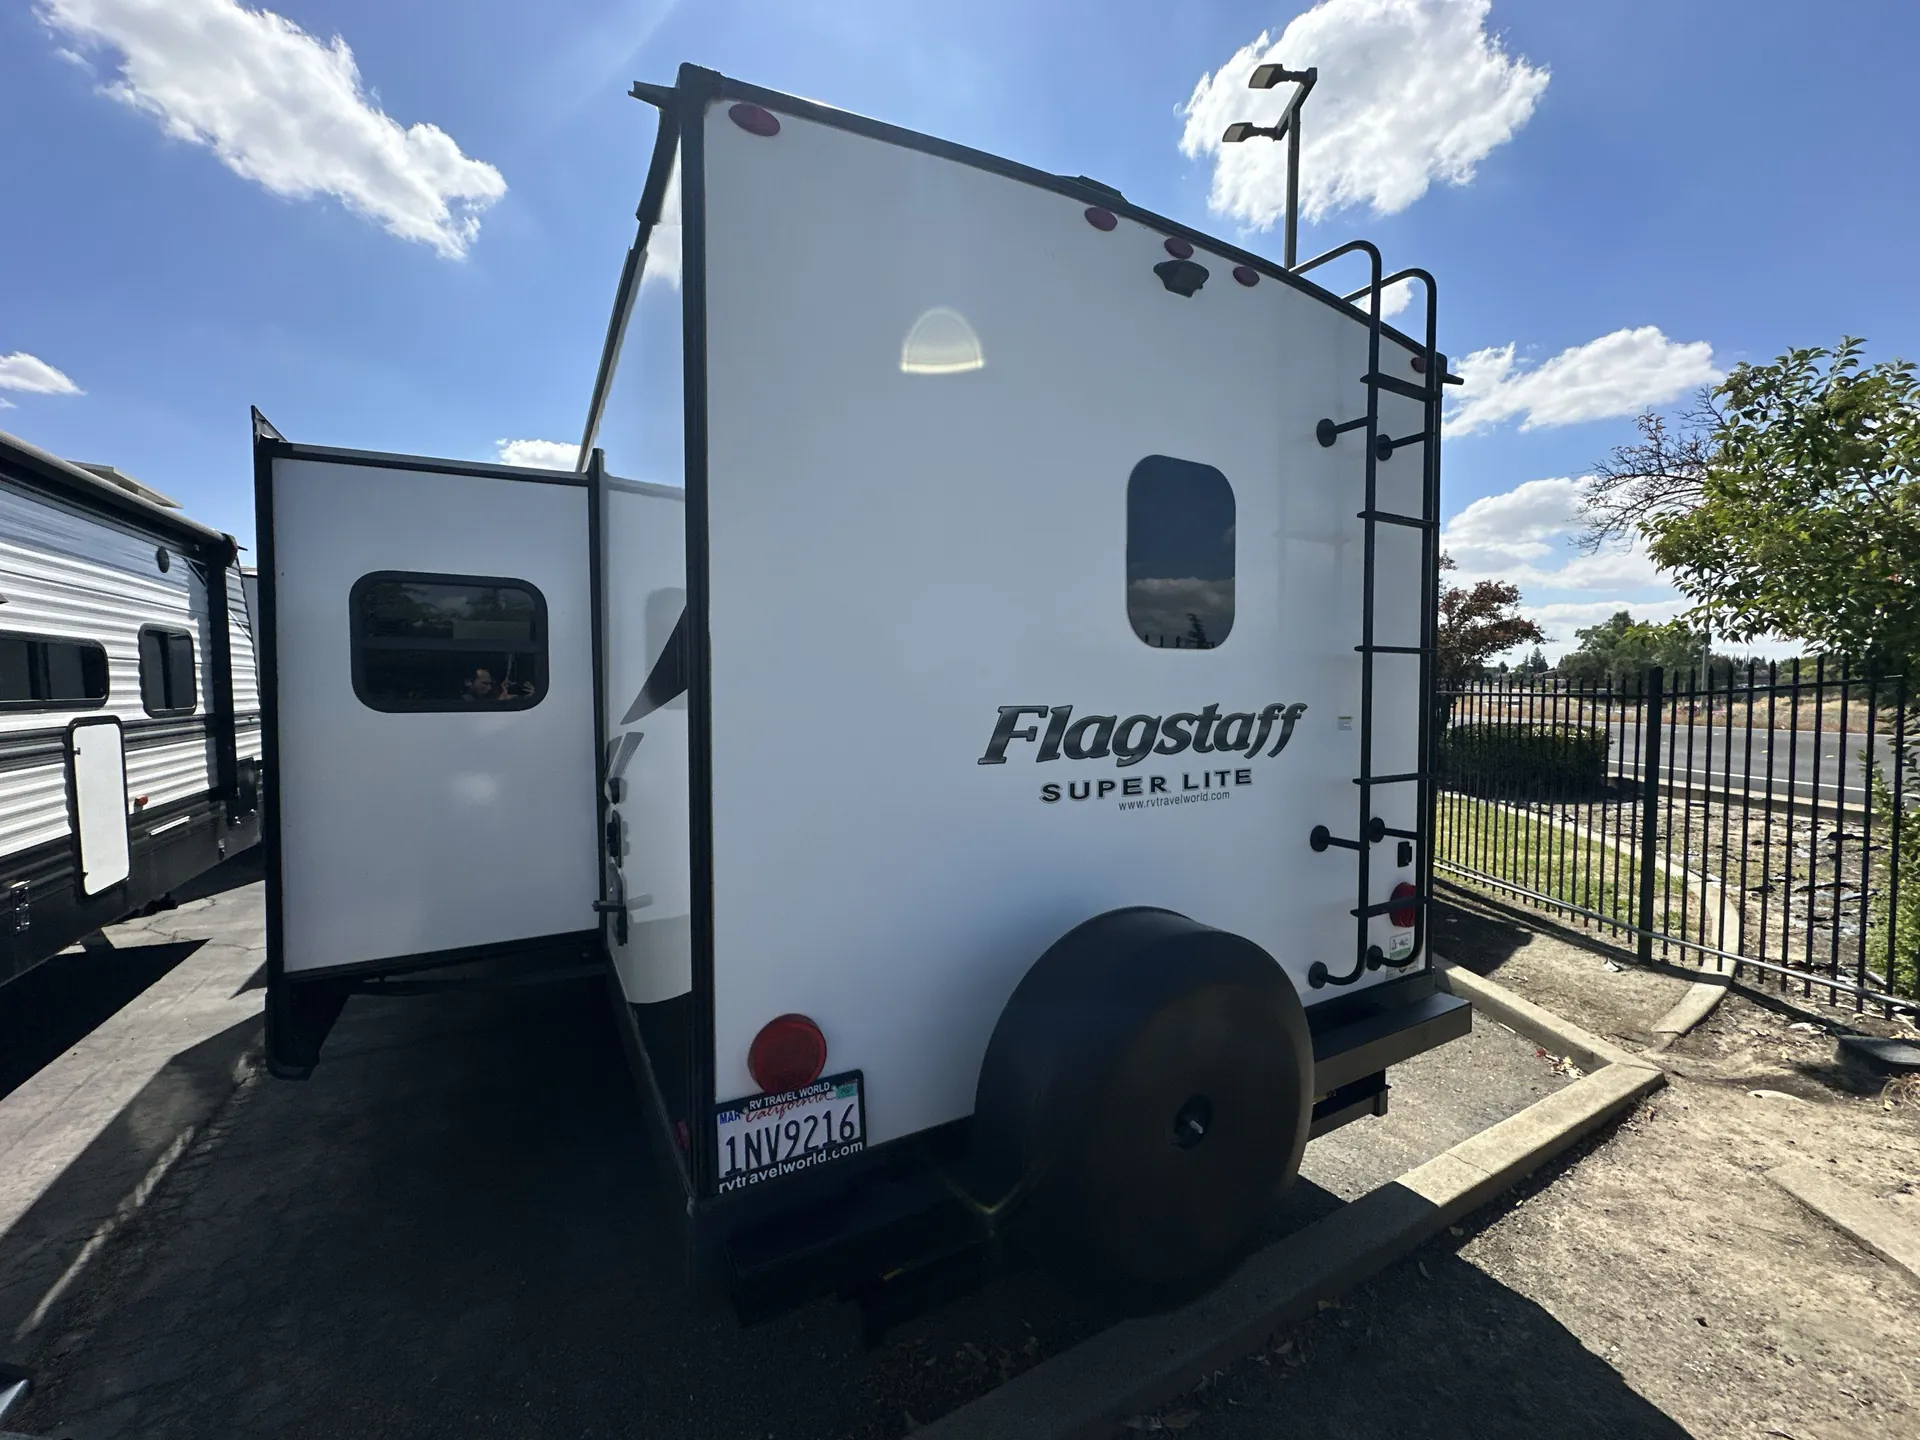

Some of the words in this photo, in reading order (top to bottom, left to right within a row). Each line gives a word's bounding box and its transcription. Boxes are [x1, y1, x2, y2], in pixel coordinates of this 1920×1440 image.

[977, 702, 1308, 768] Flagstaff
[1039, 774, 1171, 804] SUPER
[1181, 767, 1253, 792] LITE
[1118, 790, 1230, 811] www.rvtravelworld.com
[749, 1098, 763, 1110] RV
[764, 1090, 798, 1107] TRAVEL
[799, 1082, 830, 1098] WORLD
[724, 1103, 855, 1176] 1NV9216
[718, 1141, 863, 1194] rvtravelworld.com
